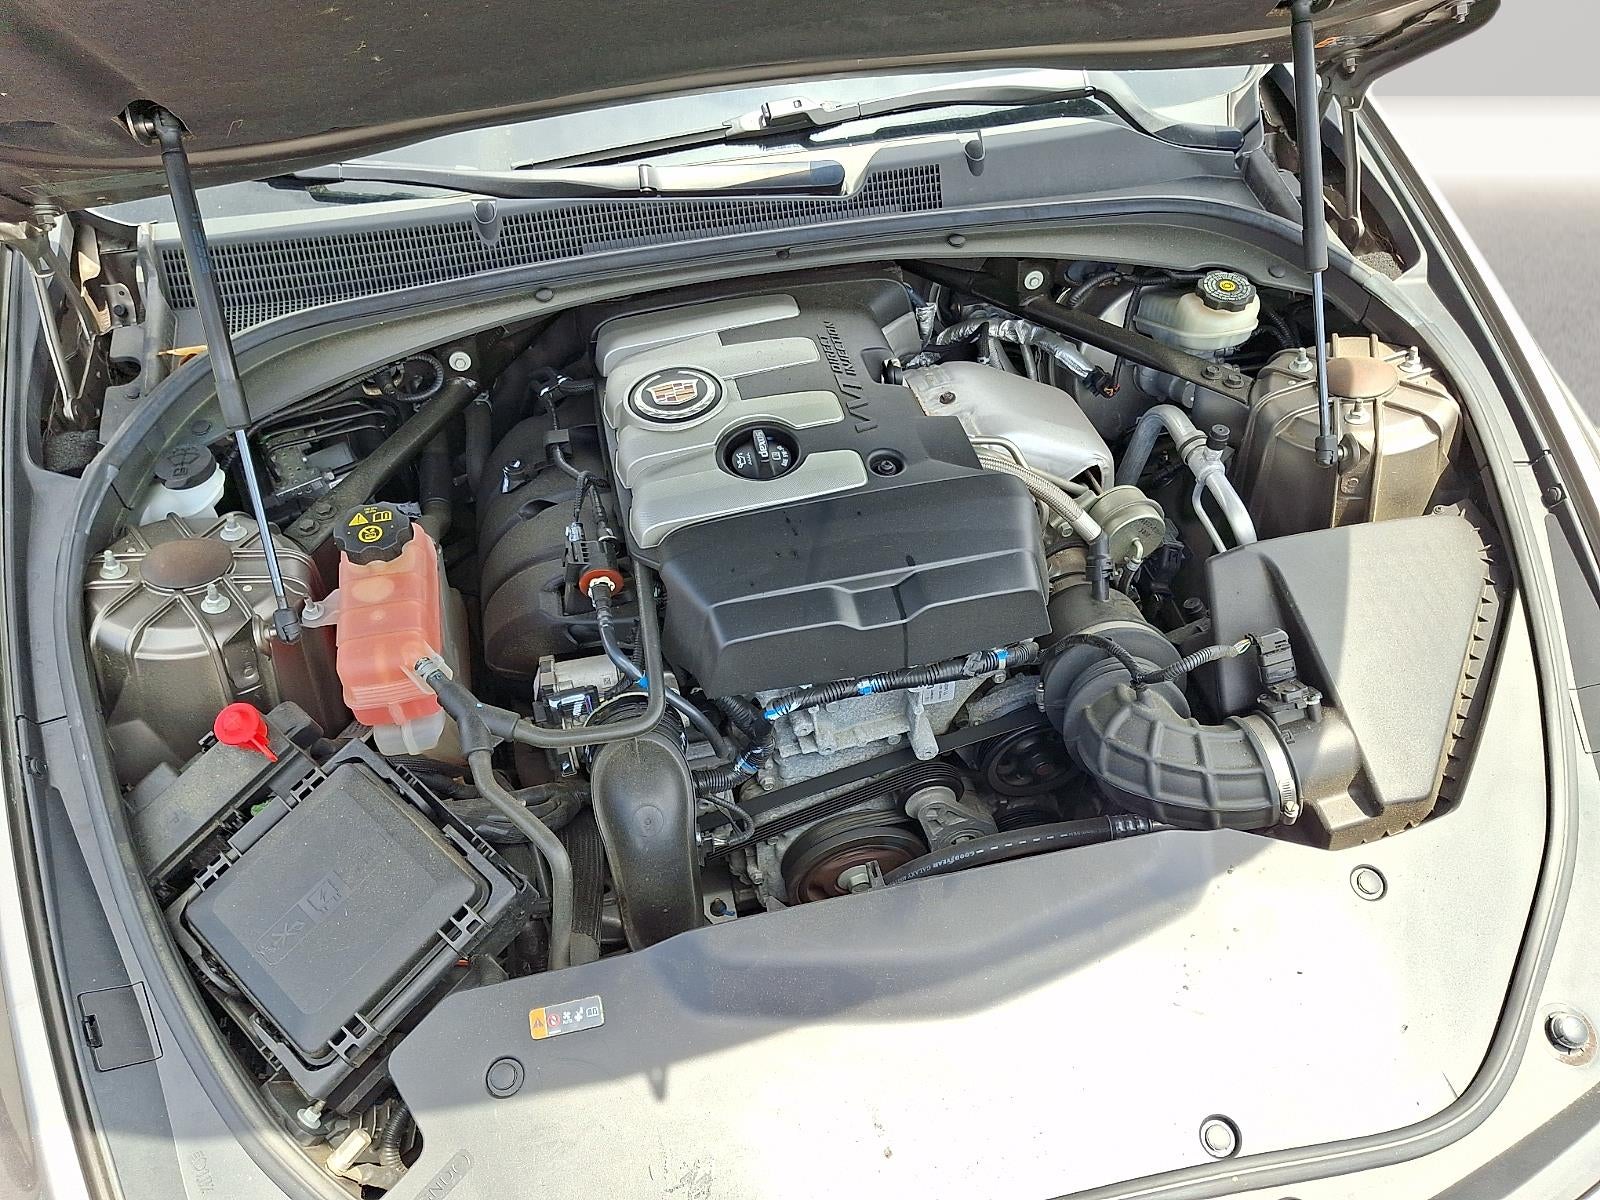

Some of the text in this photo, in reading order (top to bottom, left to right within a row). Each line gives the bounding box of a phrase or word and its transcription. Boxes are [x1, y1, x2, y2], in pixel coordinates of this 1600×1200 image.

[816, 333, 843, 374] DIRECT
[823, 320, 857, 376] INJECTION
[907, 866, 931, 880] GALAXY
[932, 850, 975, 868] GOODYEAR
